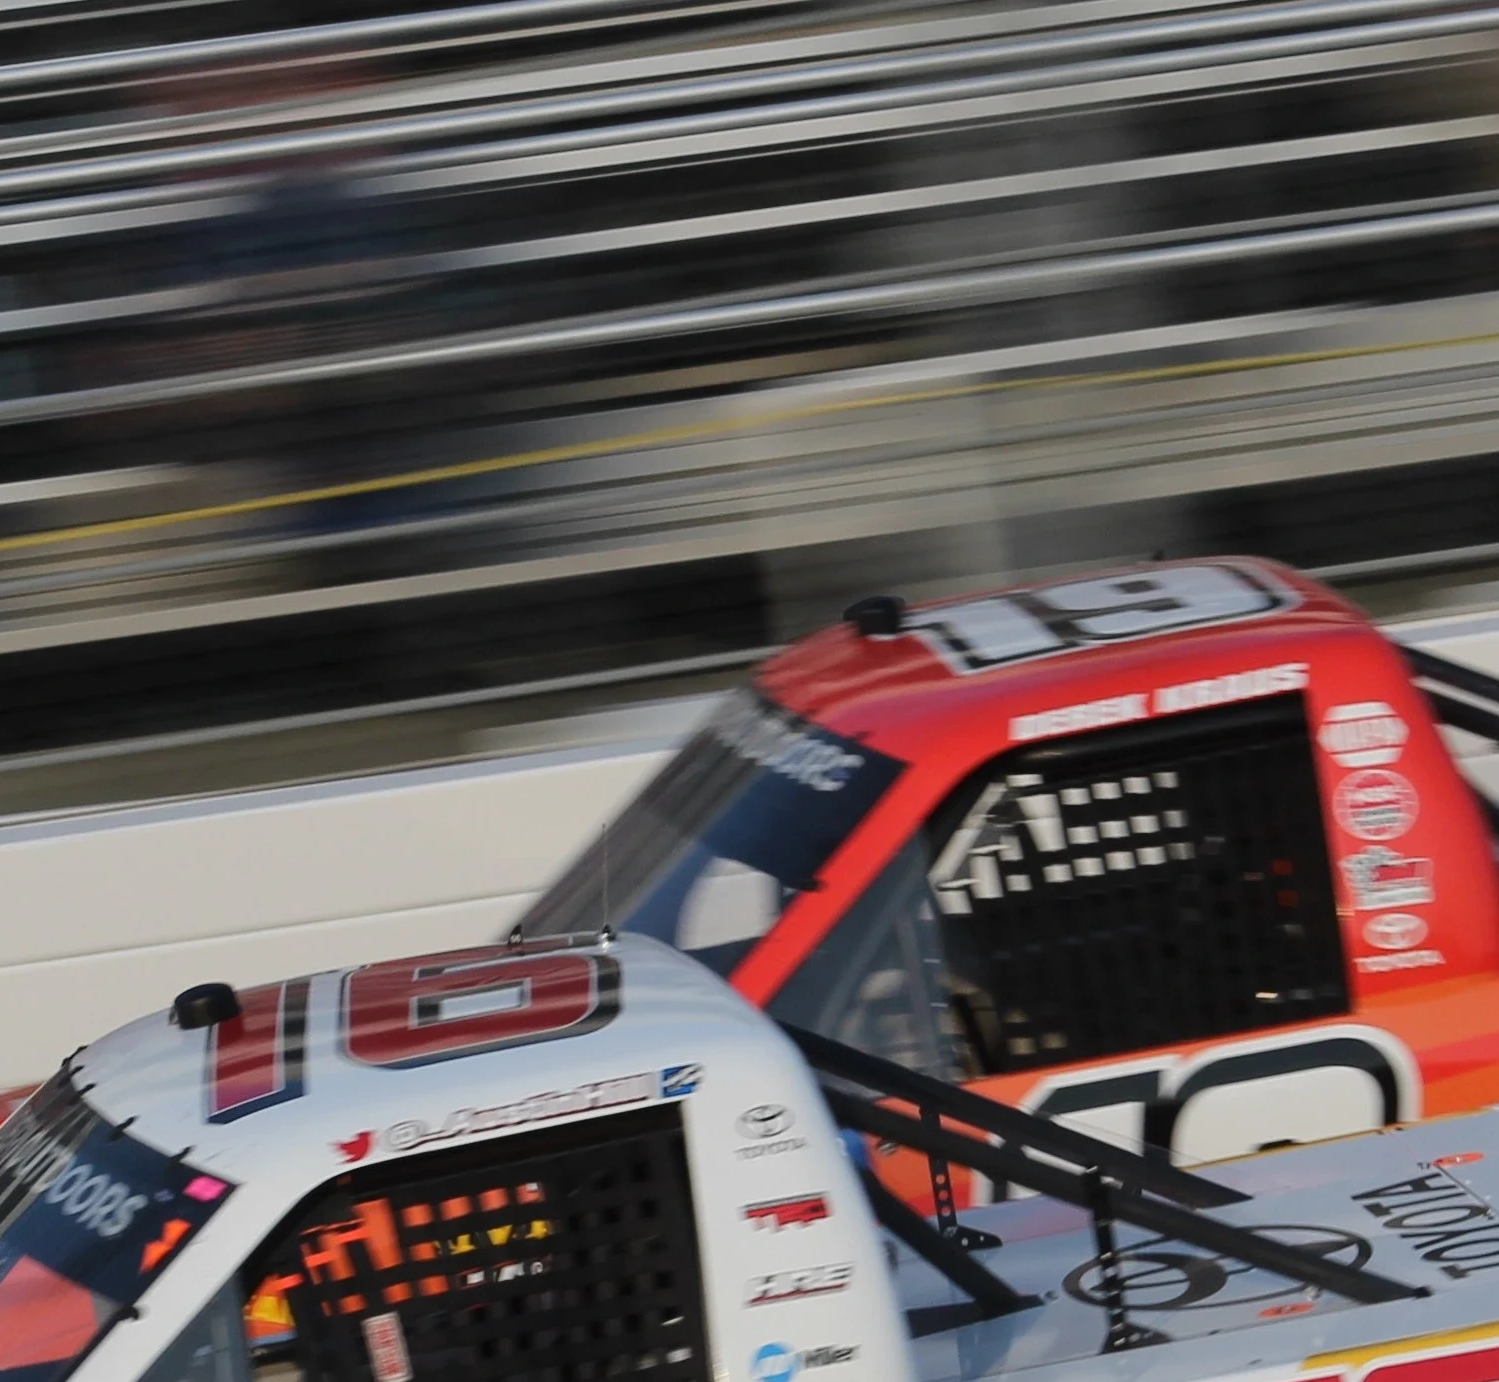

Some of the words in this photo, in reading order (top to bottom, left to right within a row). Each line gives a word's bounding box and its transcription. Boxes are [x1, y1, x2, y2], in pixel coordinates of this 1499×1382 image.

[1008, 694, 1150, 742] DEREK
[1154, 663, 1310, 714] KRAUS
[206, 945, 622, 1125] 16
